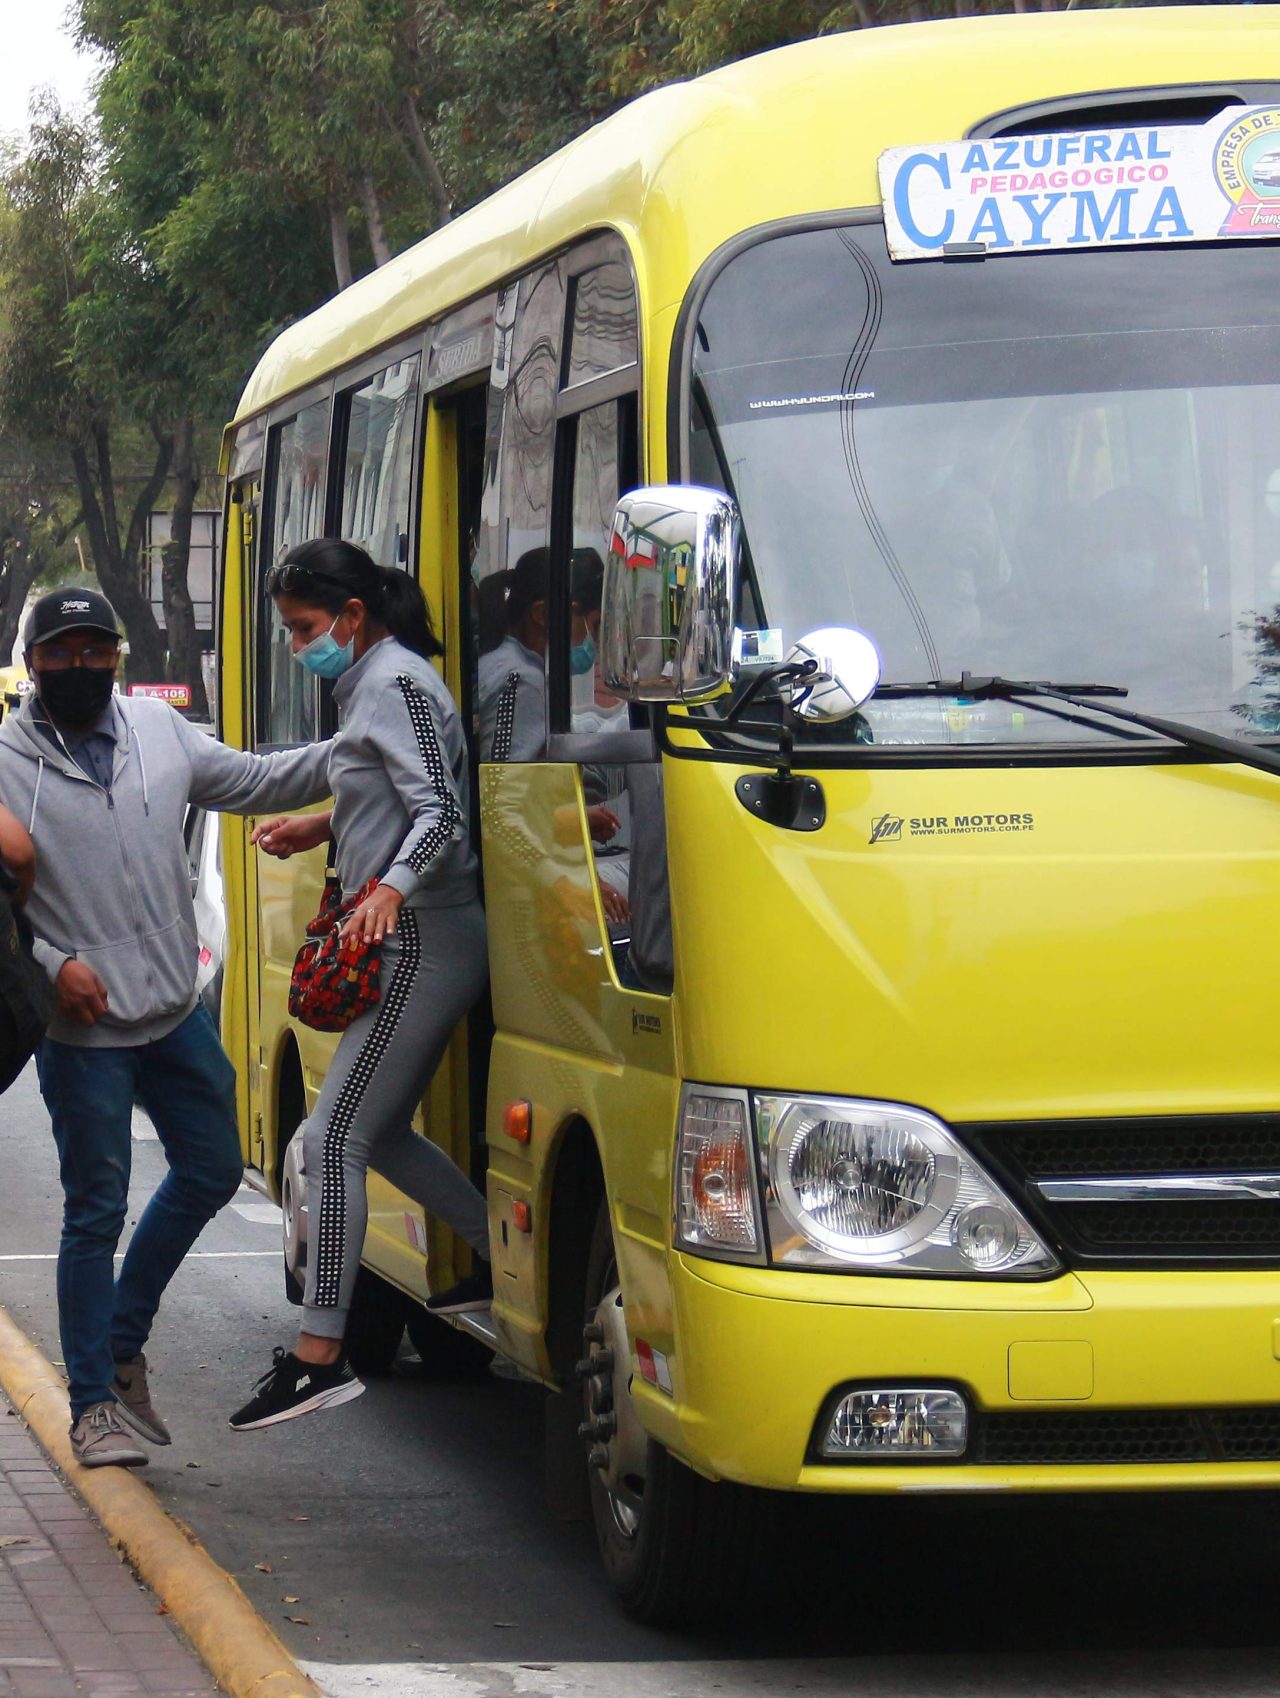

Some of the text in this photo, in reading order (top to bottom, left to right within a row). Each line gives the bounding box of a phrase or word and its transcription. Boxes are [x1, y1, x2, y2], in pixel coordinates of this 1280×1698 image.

[961, 131, 1171, 173] AZUFRAL
[1221, 114, 1273, 190] EMPRESA DE
[970, 164, 1169, 195] PEDAGOGICO
[149, 689, 186, 699] A-105
[910, 813, 1034, 829] SUR MOTORS
[910, 824, 1034, 836] WWW.SURMOTORS.COM.PE
